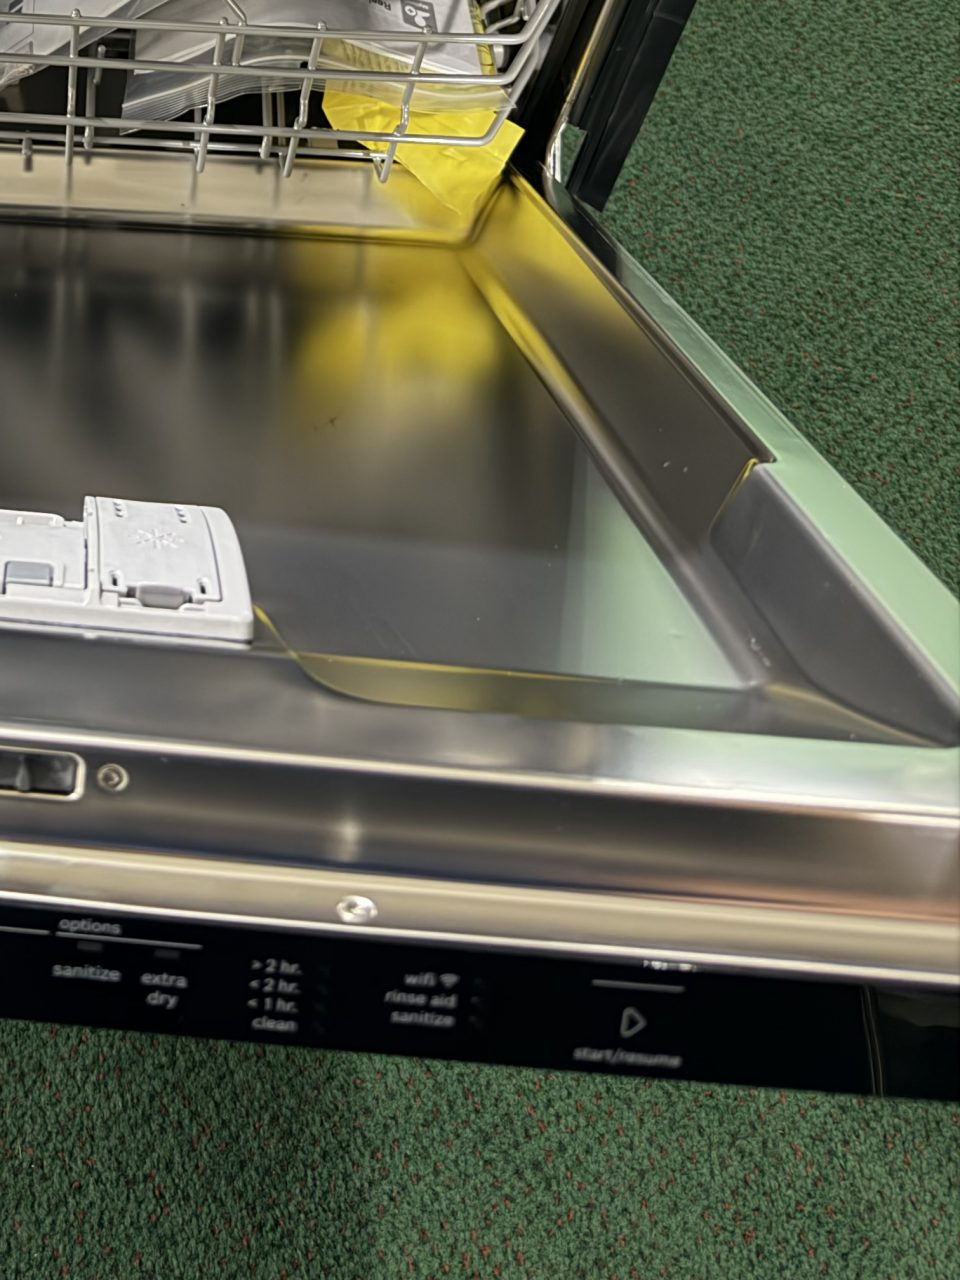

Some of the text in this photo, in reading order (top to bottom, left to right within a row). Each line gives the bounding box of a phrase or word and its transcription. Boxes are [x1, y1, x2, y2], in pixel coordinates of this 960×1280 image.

[58, 917, 123, 936] options
[51, 962, 189, 989] sanitize extra
[265, 957, 277, 975] 2
[279, 959, 302, 976] hr.
[262, 977, 274, 993] 2
[276, 978, 301, 995] hr.
[403, 971, 437, 988] wifi
[145, 990, 179, 1010] dry
[263, 996, 273, 1011] 1
[274, 997, 299, 1014] hr.
[384, 989, 459, 1009] rinse aid
[250, 1015, 298, 1034] clean
[390, 1009, 456, 1029] sanitize
[572, 1046, 683, 1069] start/resume
